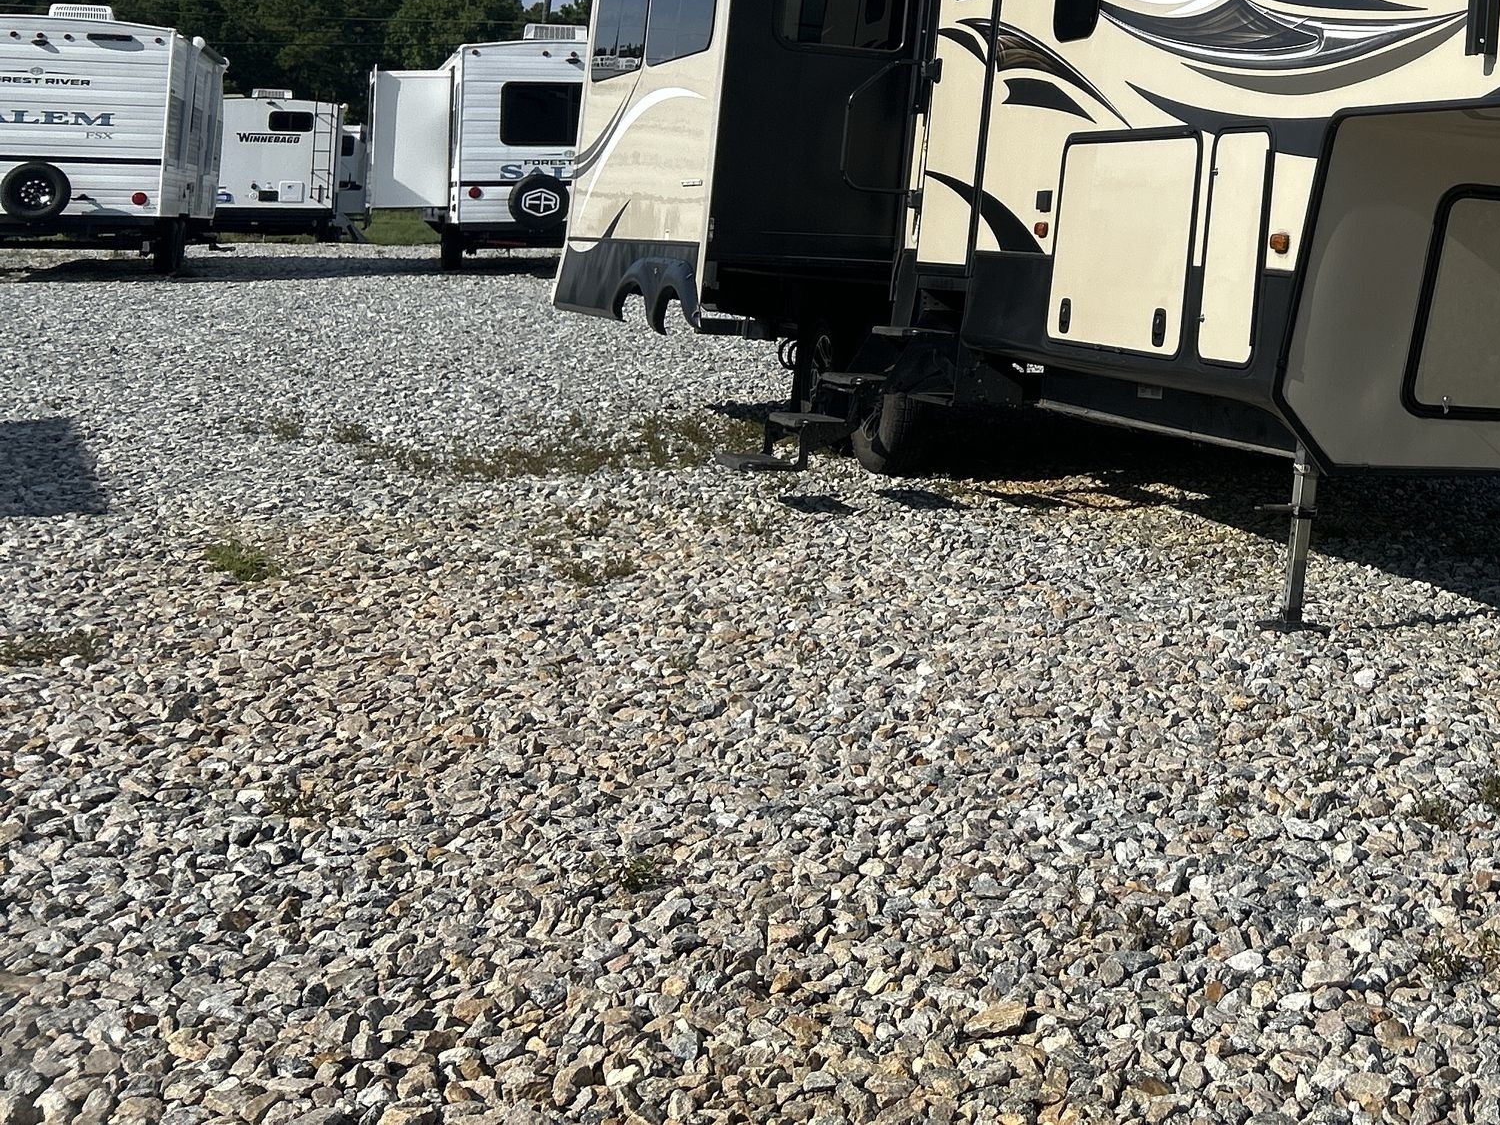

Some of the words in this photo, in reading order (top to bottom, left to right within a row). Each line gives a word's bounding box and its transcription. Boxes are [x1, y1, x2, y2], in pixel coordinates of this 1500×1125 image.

[0, 76, 42, 84] REST
[45, 78, 91, 86] RIVER
[86, 131, 114, 140] FSX
[236, 132, 302, 144] WINNEBAGO
